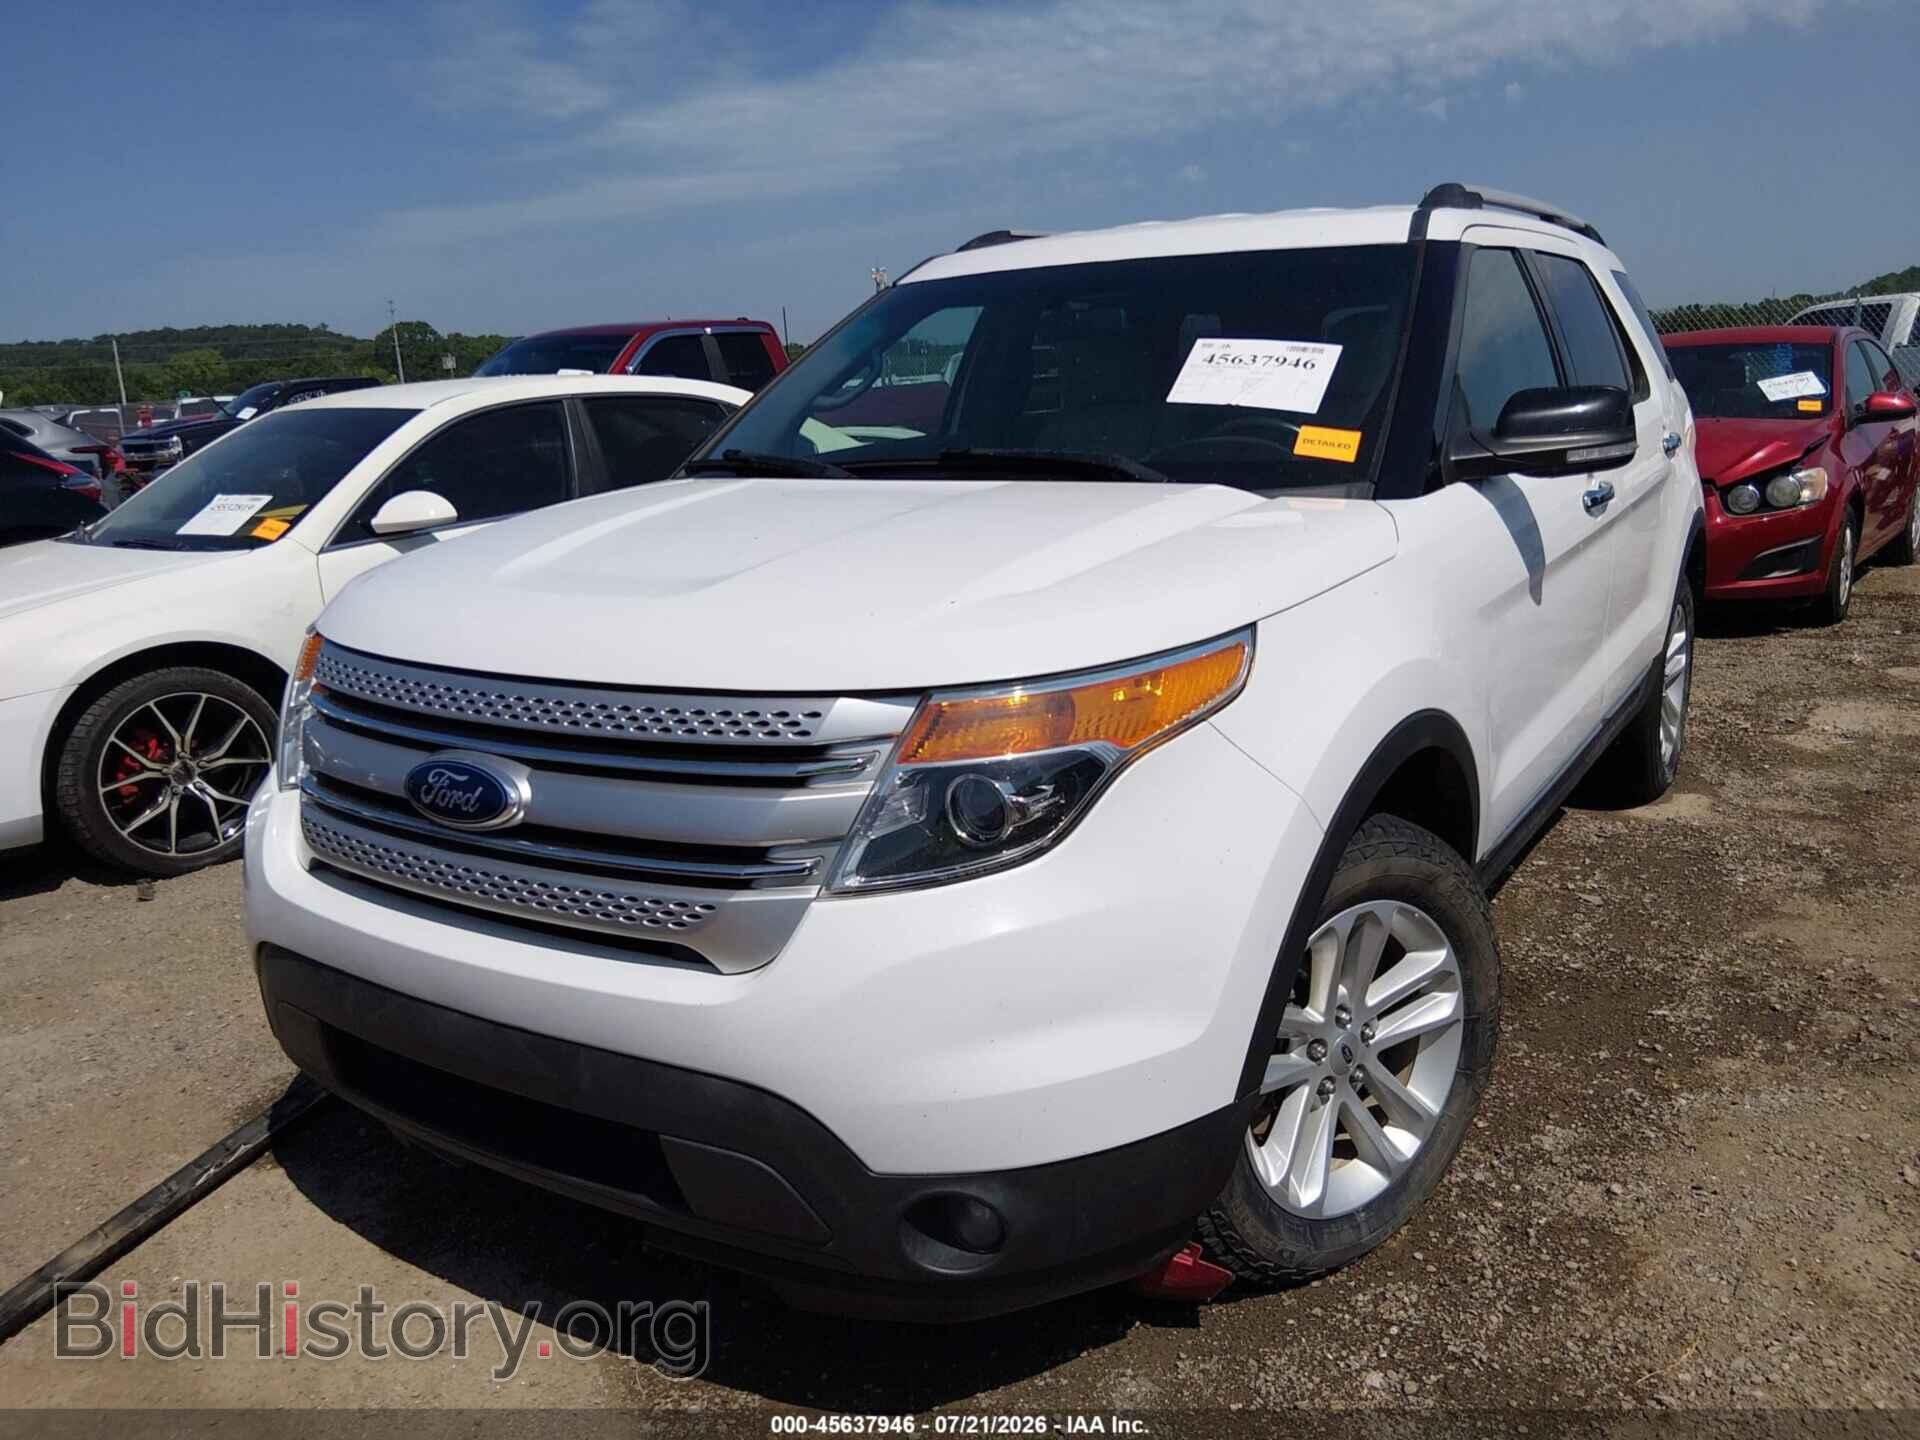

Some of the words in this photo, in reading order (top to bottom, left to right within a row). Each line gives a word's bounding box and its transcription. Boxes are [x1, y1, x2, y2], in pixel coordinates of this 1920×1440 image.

[1202, 353, 1316, 370] 45637946
[1302, 438, 1352, 450] DETAILED
[420, 768, 483, 813] Ford
